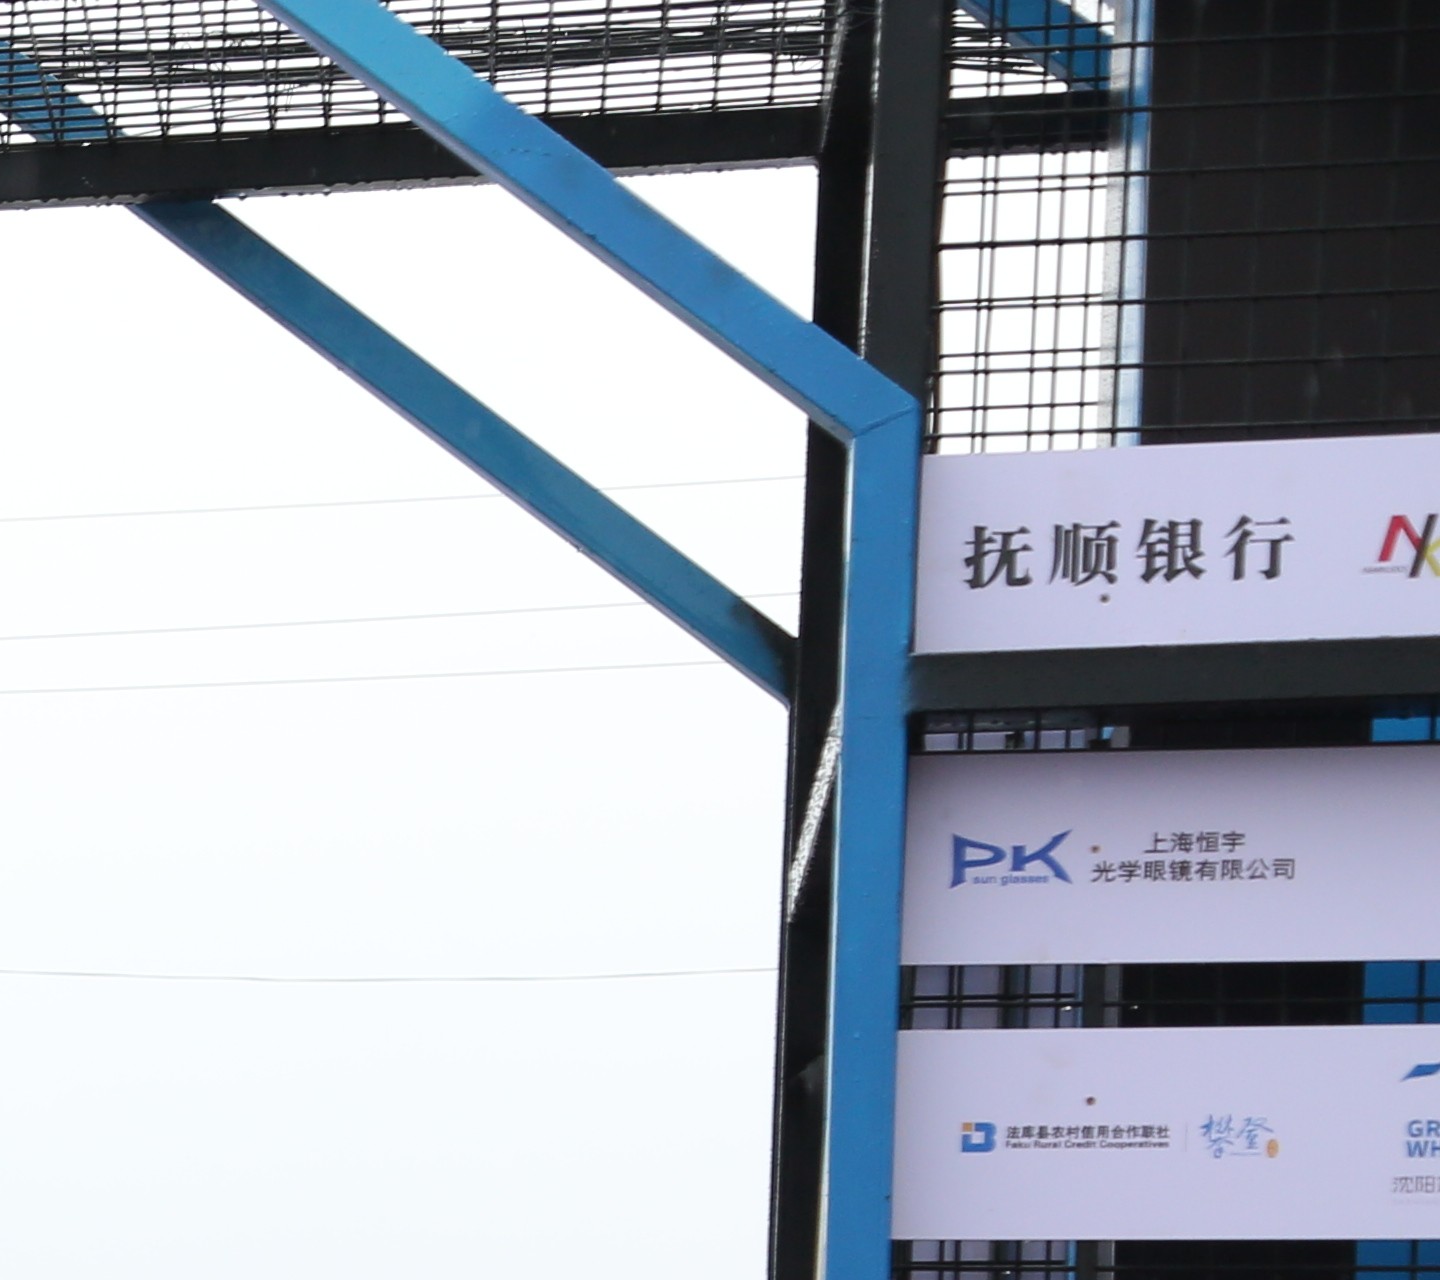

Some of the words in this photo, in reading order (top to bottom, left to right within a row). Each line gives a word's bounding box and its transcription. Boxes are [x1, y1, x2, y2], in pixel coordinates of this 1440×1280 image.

[963, 516, 1294, 588] 抚顺银行
[1144, 832, 1246, 854] 上海恒宇
[949, 830, 1073, 889] PK
[1091, 858, 1296, 884] 光学眼镜有限公司
[973, 875, 996, 885] sun
[1006, 1125, 1170, 1139] 法库县农村信用合作联社
